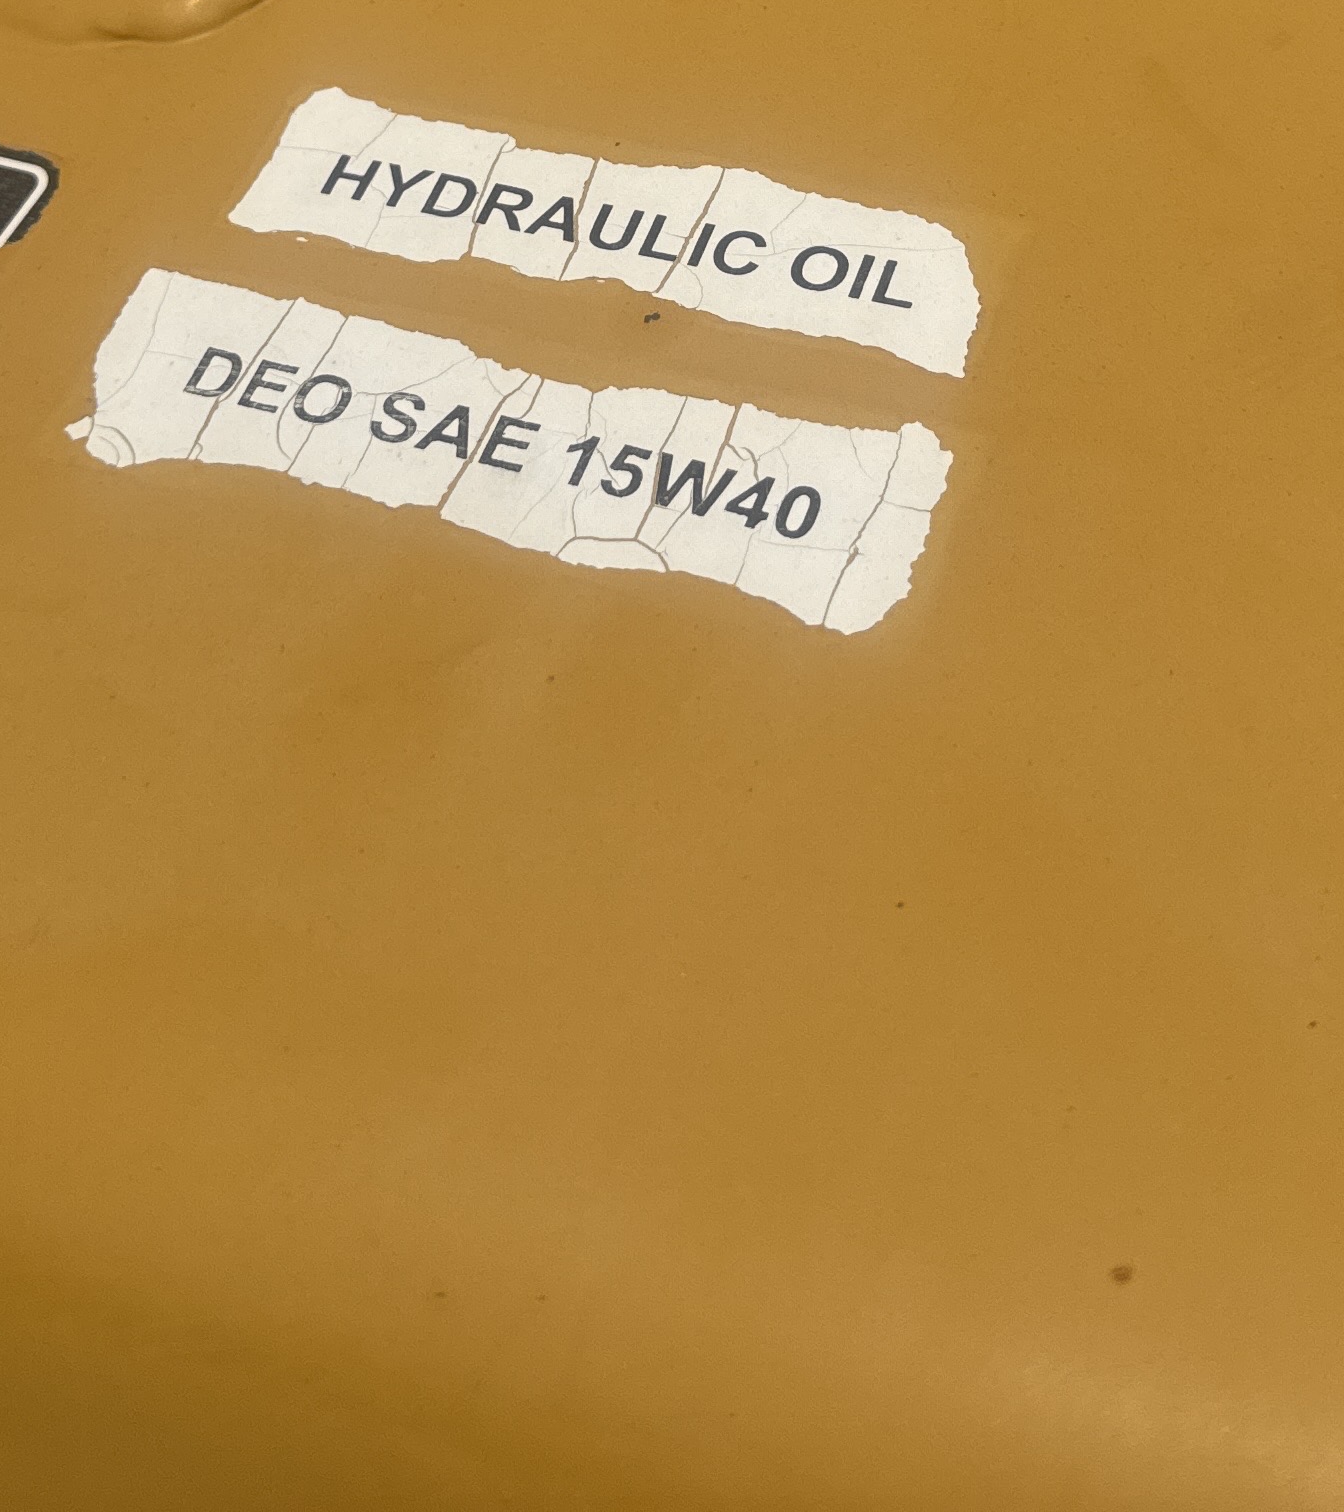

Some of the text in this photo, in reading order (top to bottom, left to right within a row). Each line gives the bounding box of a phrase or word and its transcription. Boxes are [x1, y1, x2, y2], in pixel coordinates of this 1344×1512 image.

[319, 153, 914, 309] HYDRAULIC OIL
[183, 346, 823, 540] DEO SAE 15W40
